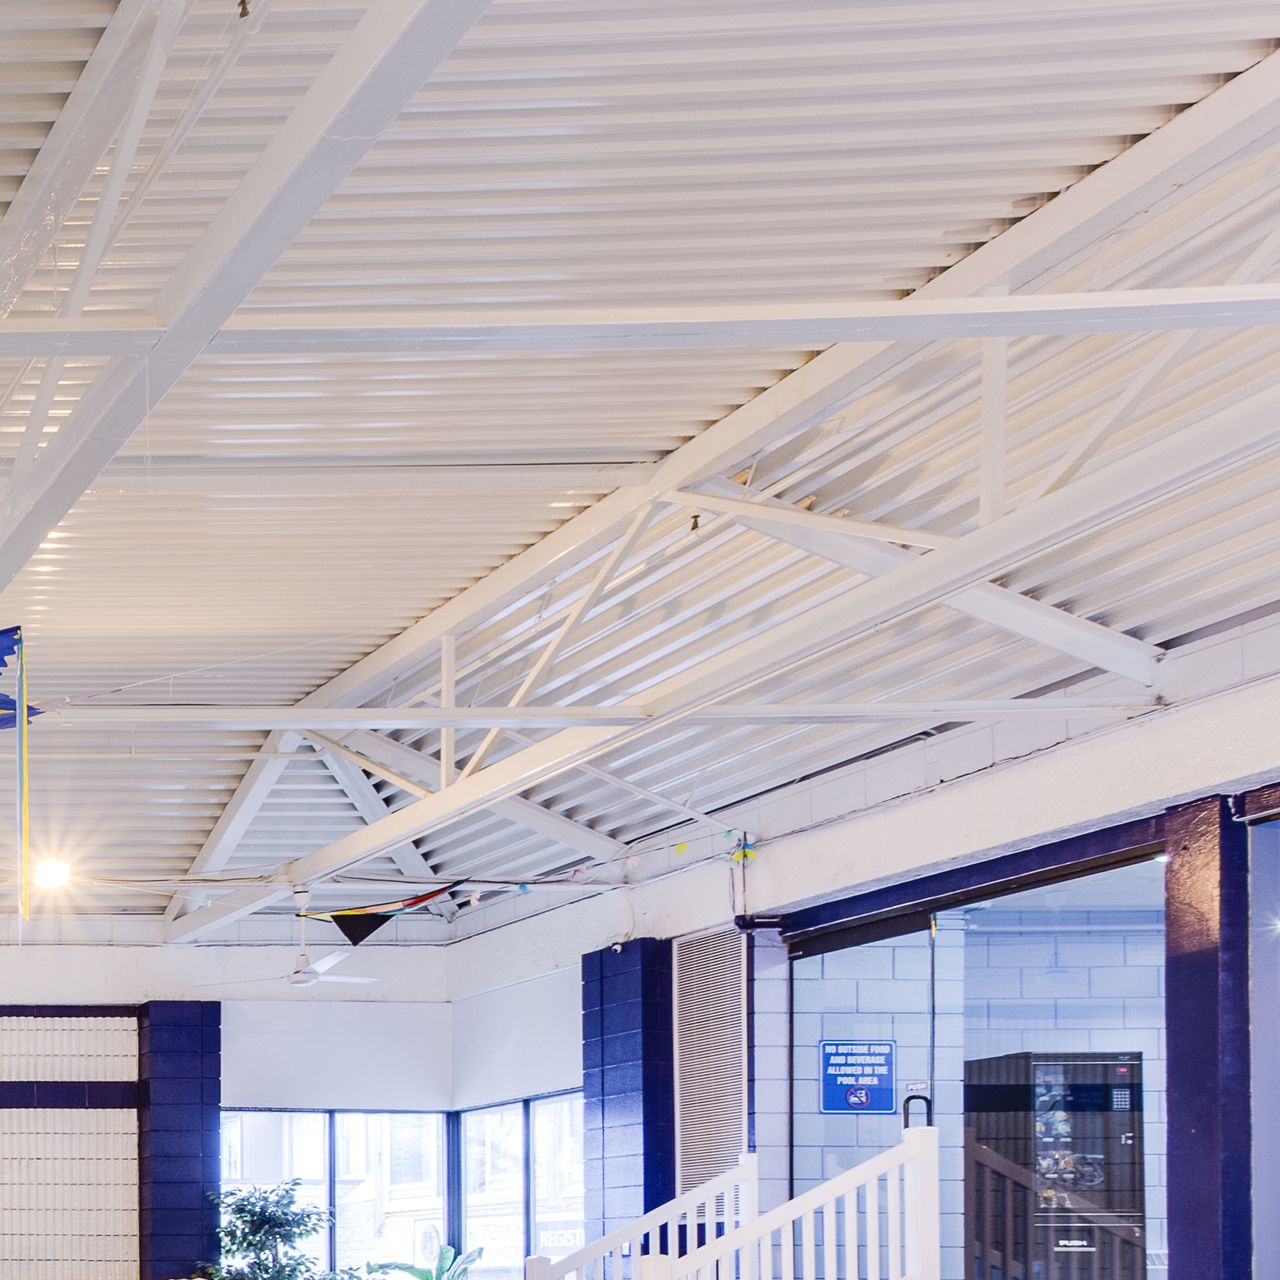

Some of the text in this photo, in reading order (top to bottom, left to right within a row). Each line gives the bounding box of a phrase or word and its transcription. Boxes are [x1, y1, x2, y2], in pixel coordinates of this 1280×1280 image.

[825, 1045, 890, 1054] NO OUTSIDE FOOD
[829, 1056, 886, 1064] AND BEVERAGE
[826, 1066, 888, 1074] ALLOWED IN THE
[836, 1076, 879, 1085] POOL AREA
